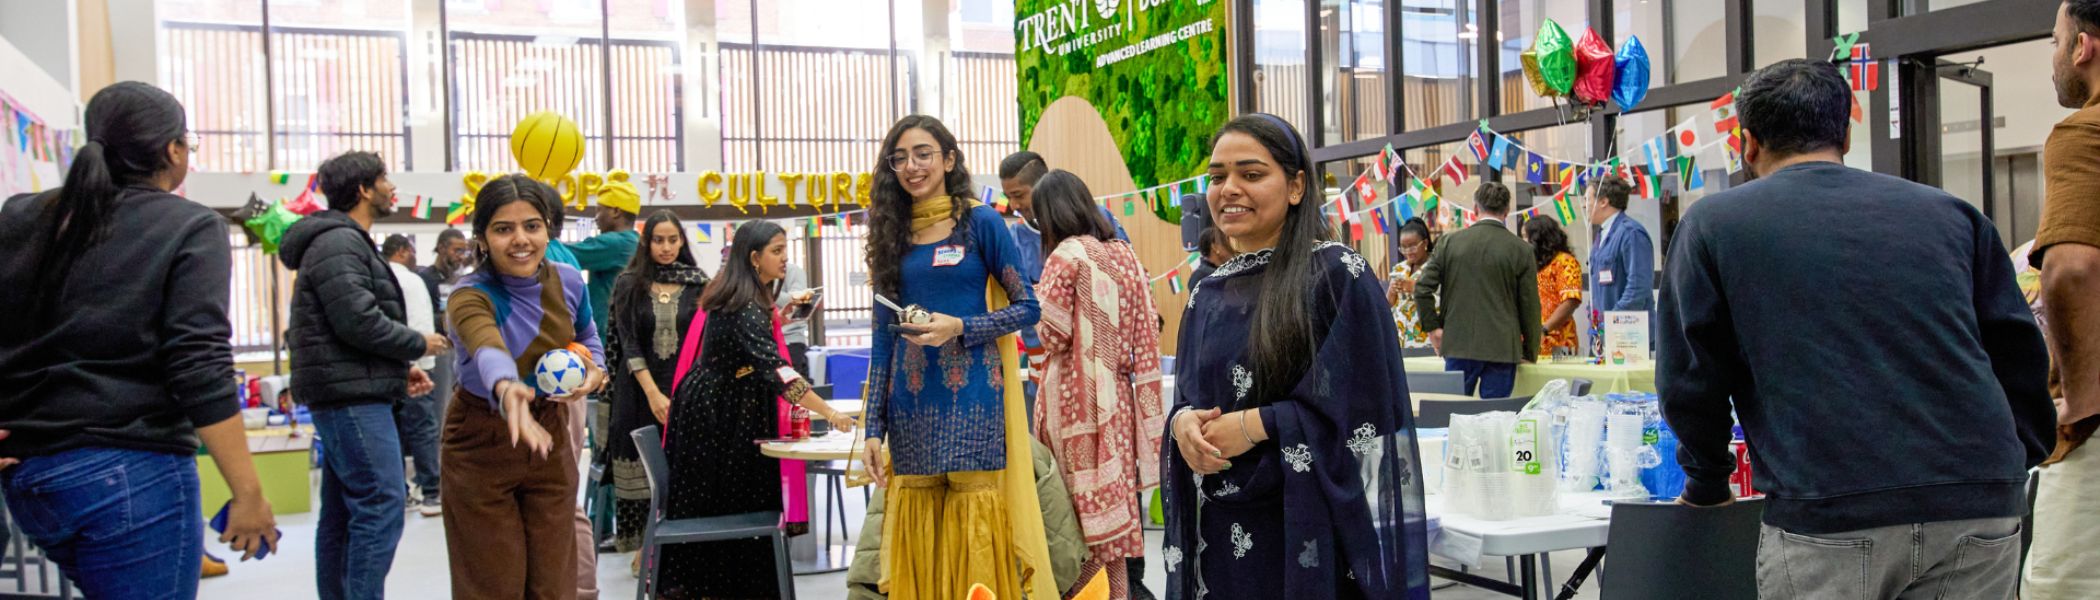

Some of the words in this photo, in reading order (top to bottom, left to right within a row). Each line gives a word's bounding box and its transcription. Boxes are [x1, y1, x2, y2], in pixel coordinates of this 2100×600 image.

[1018, 0, 1089, 55] TRENT
[1058, 23, 1121, 56] UNIVERSITY
[1096, 44, 1136, 68] ADVANCED
[1135, 30, 1178, 55] LEARNING
[1178, 18, 1212, 40] CENTRE
[1516, 450, 1532, 462] 20
